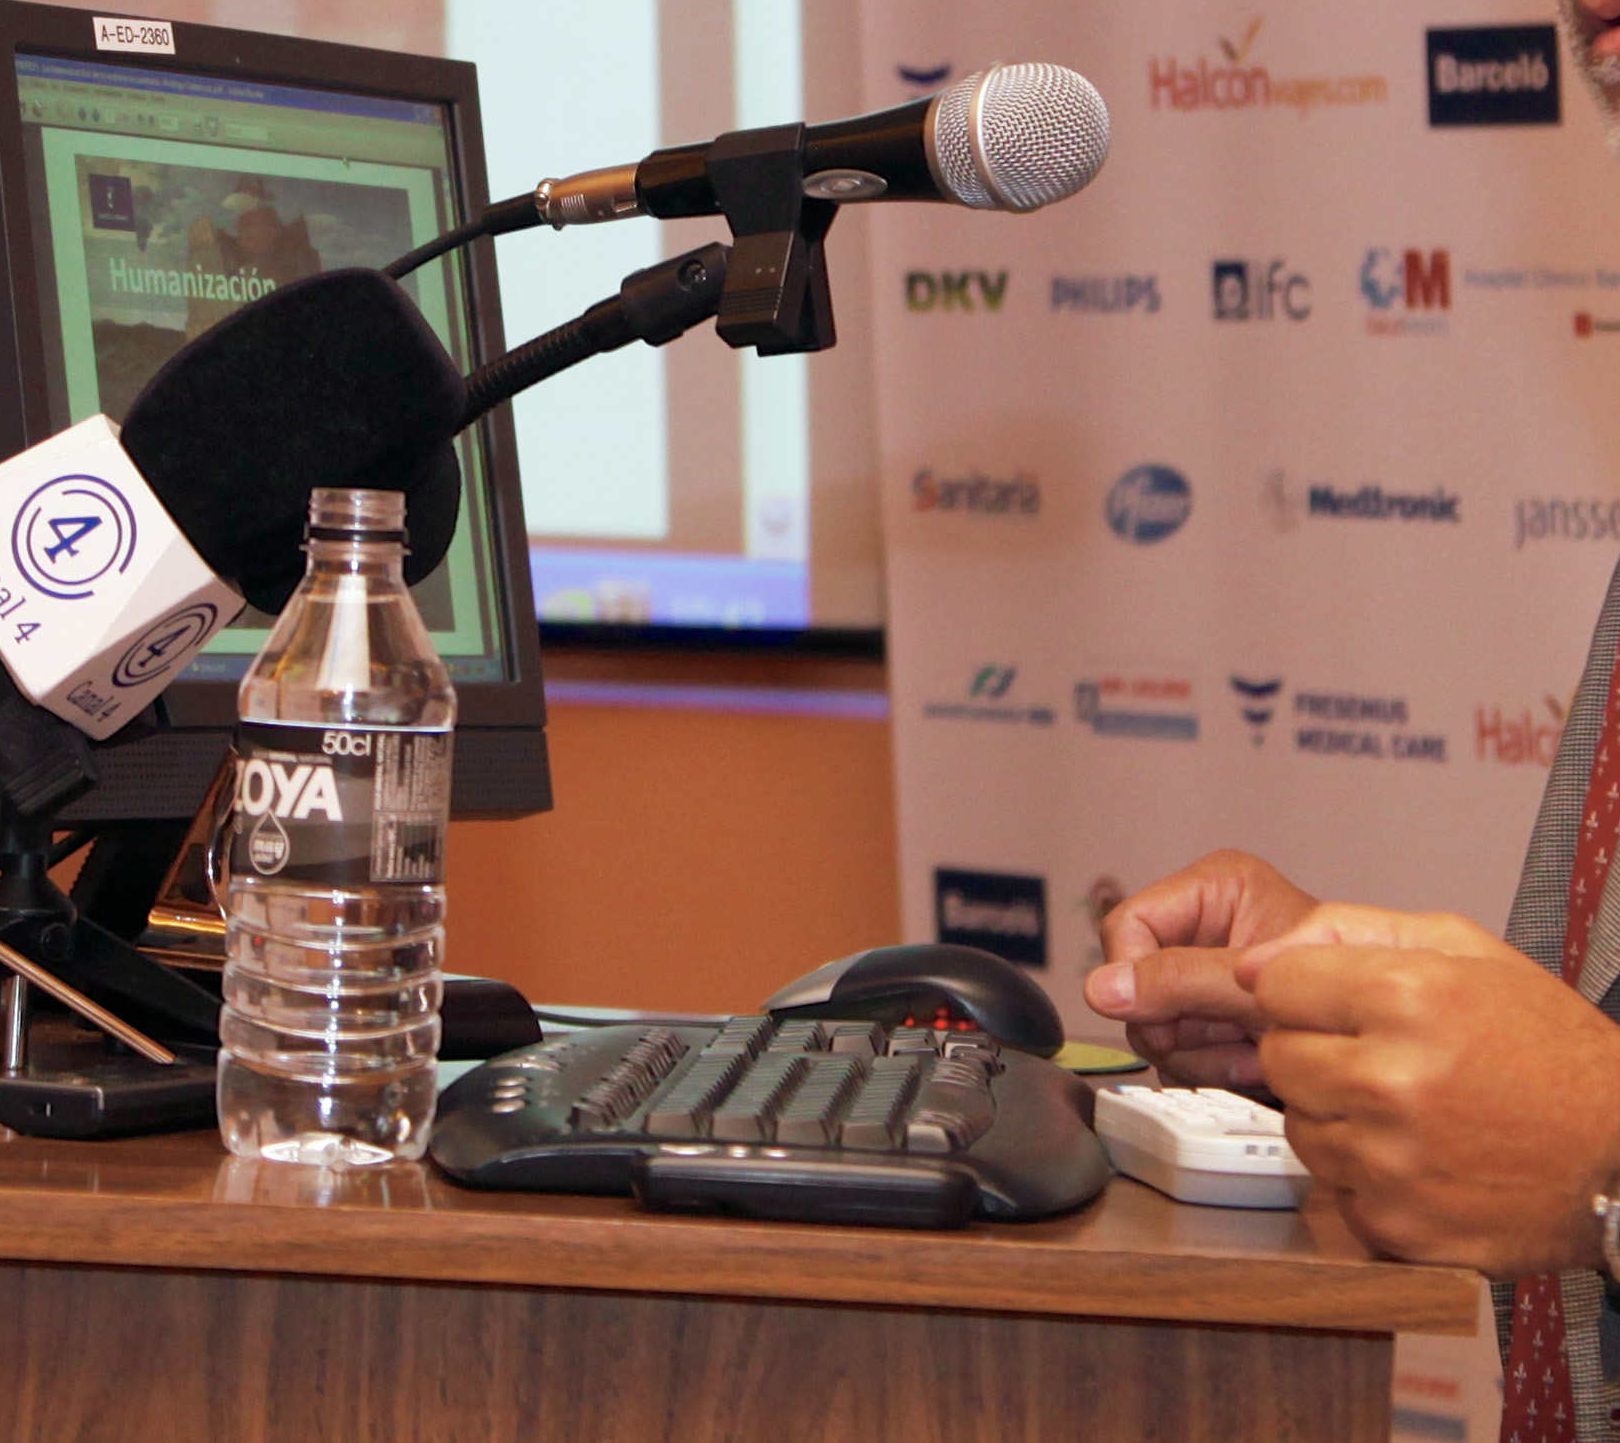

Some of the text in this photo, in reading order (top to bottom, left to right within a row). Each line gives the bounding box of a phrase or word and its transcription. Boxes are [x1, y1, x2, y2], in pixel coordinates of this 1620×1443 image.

[99, 23, 171, 47] A-ED-2360
[1434, 46, 1552, 93] Barceló
[109, 256, 277, 303] Humanización
[904, 267, 1009, 315] DKV
[1049, 273, 1162, 316] PHILIPS
[1308, 484, 1461, 525] Medtronic
[43, 515, 104, 566] 4
[13, 620, 43, 645] 4
[137, 624, 192, 669] 4
[66, 679, 115, 717] Canal
[1294, 691, 1409, 725] FRESENIUS
[322, 730, 372, 757] 50cl
[1295, 728, 1448, 764] MEDICAL CARE
